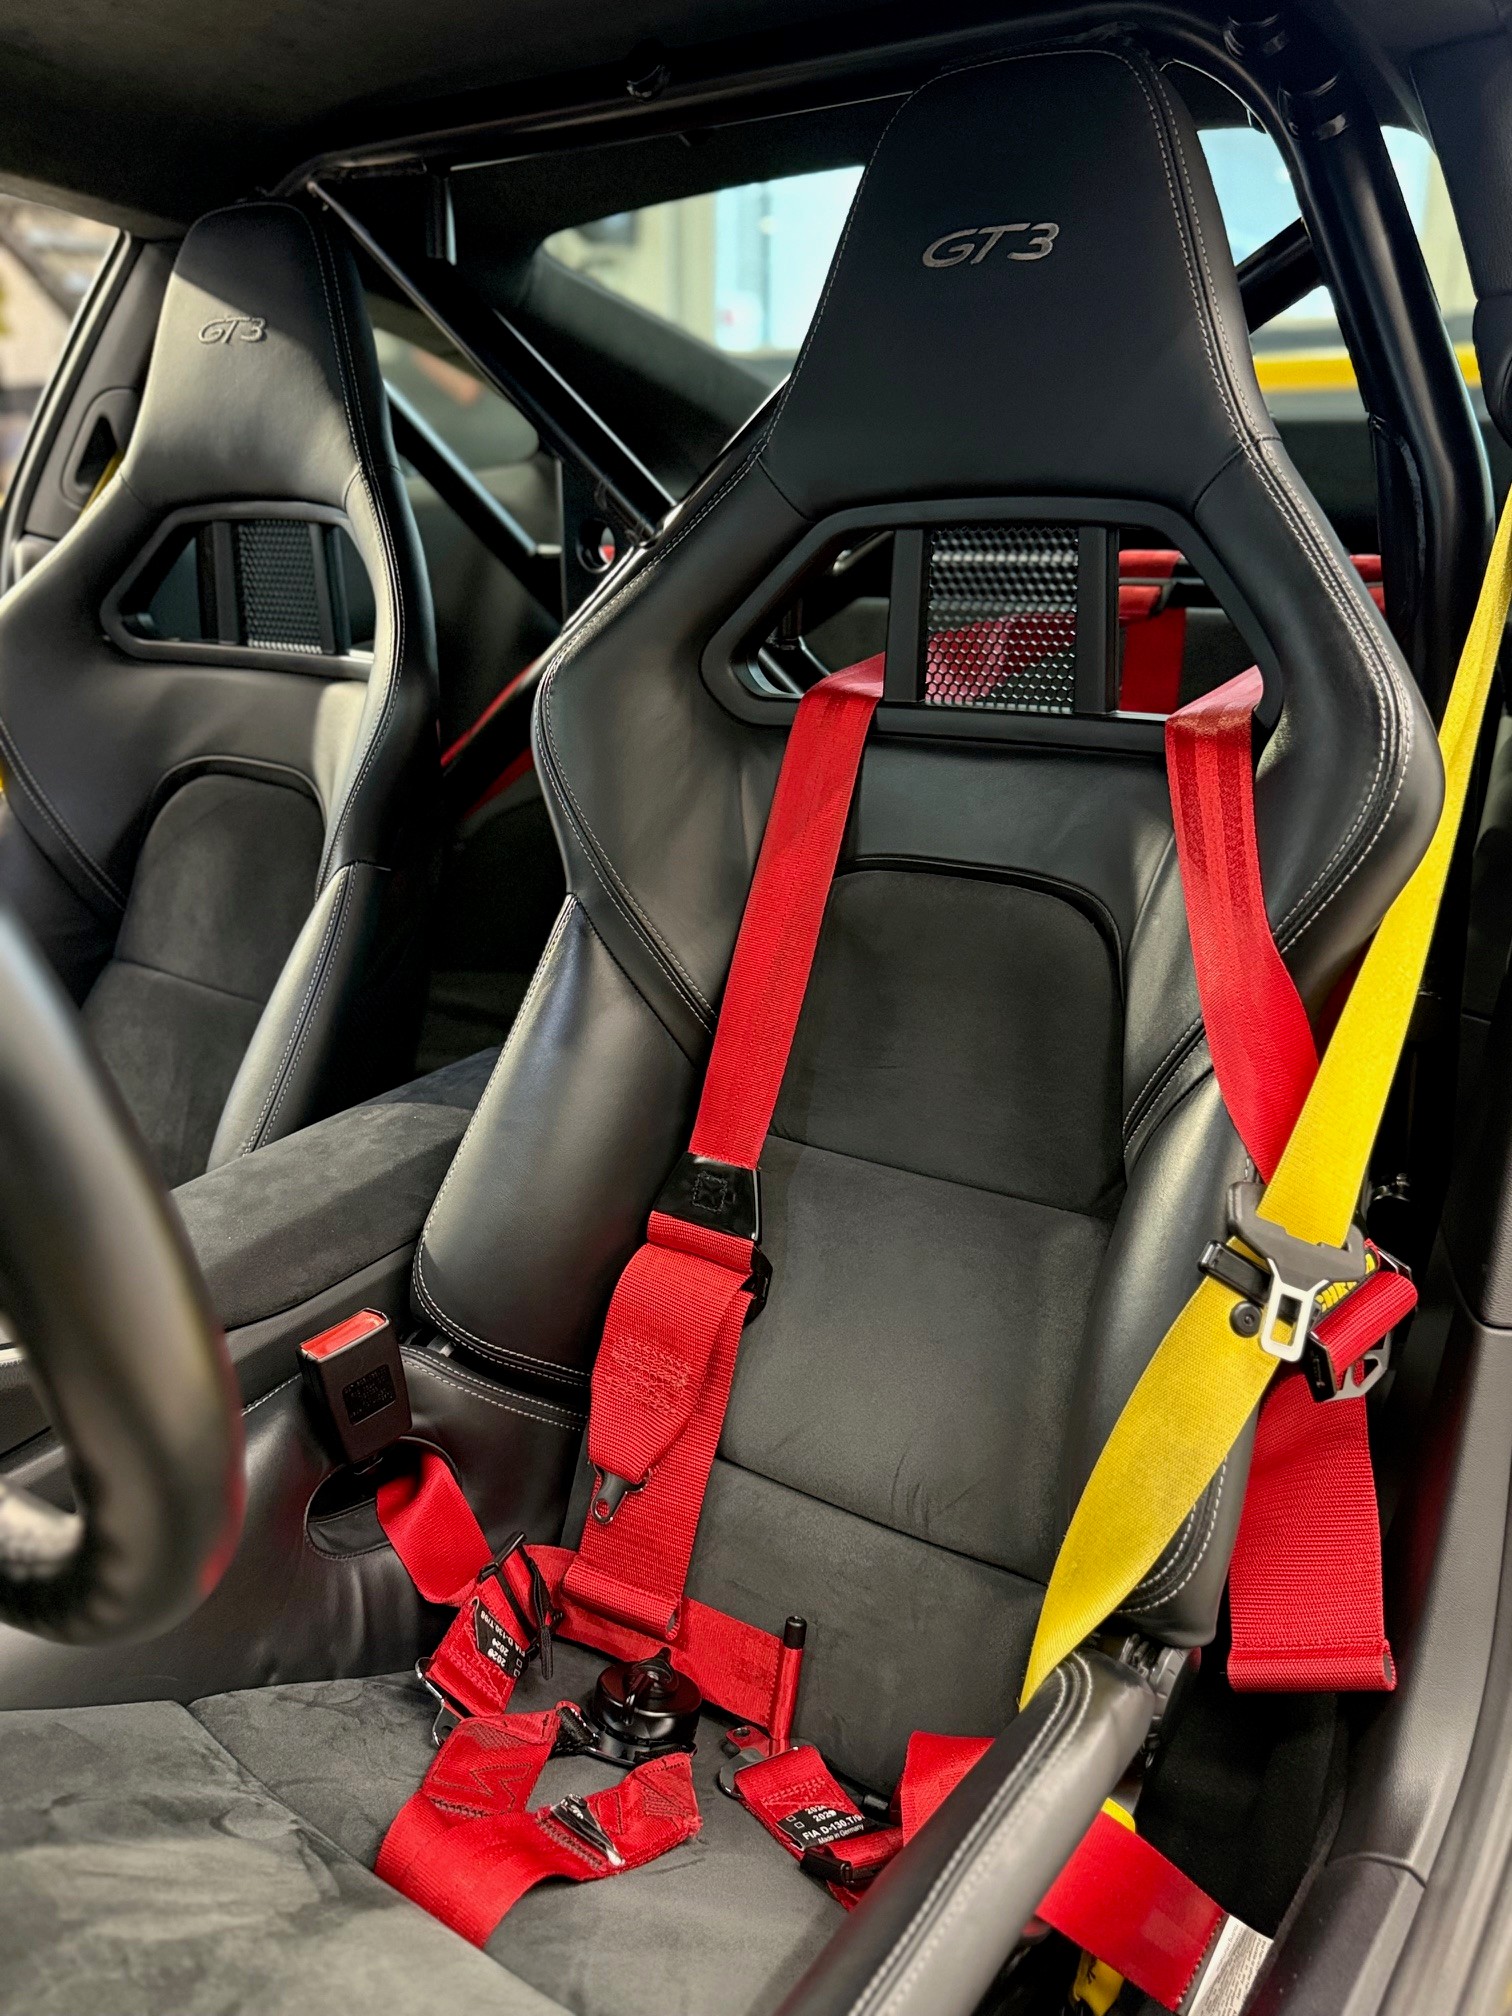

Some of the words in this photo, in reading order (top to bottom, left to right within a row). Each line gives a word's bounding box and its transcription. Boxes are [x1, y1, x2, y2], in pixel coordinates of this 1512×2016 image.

[922, 222, 1060, 268] GT3
[198, 316, 266, 344] GT3
[802, 1828, 821, 1841] FIA
[817, 1833, 834, 1844] Made
[840, 1824, 864, 1839] Germany
